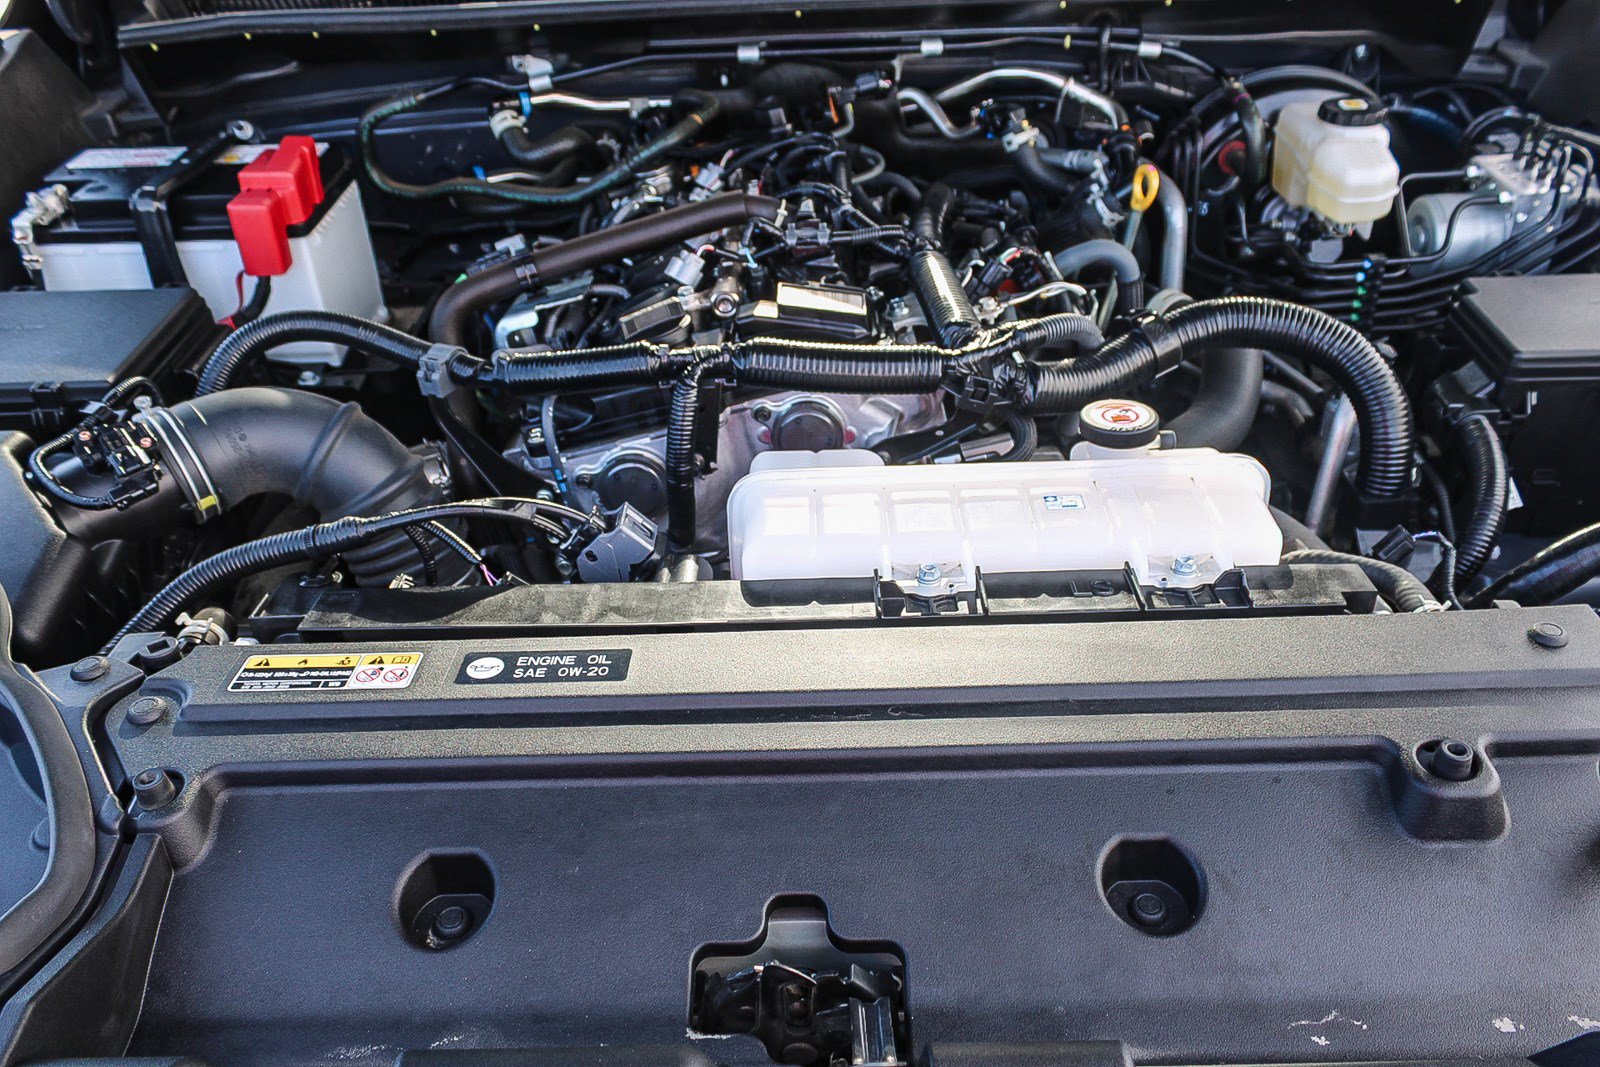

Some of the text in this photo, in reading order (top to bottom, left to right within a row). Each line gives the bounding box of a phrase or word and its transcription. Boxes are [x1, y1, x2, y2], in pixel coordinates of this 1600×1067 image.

[516, 654, 612, 666] ENGINE OIL
[512, 666, 609, 678] SAE 0W-20
